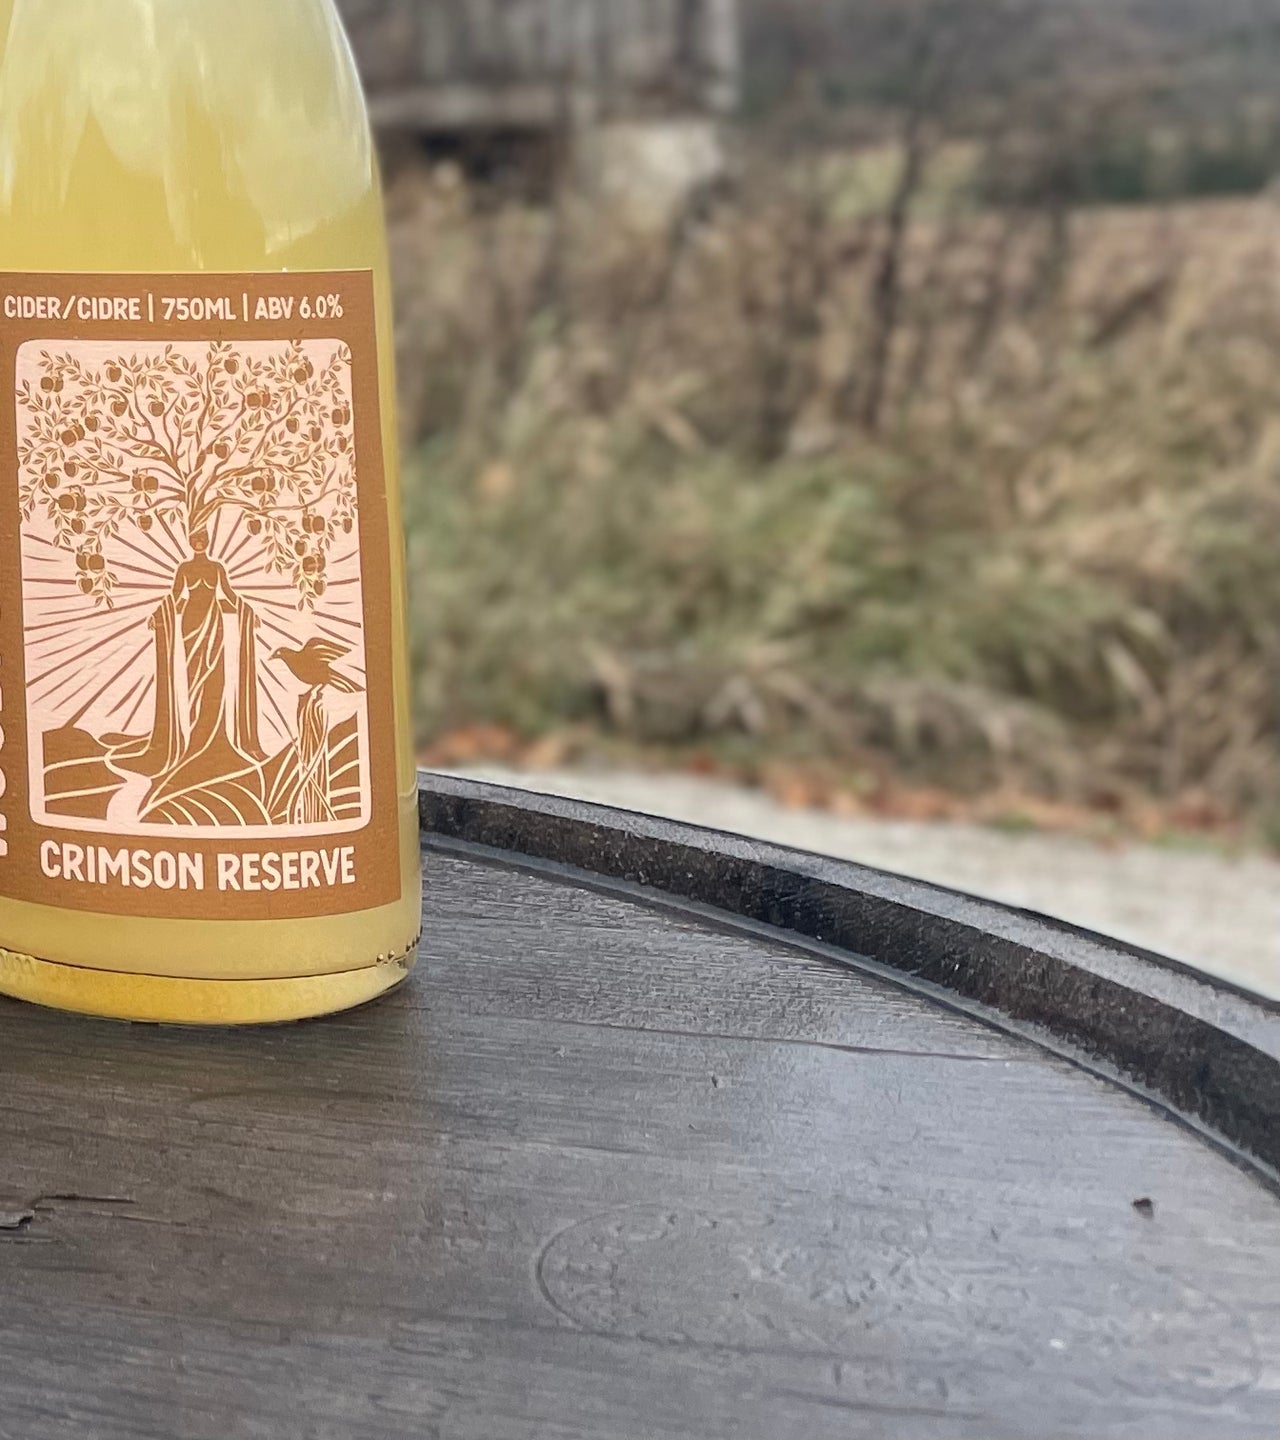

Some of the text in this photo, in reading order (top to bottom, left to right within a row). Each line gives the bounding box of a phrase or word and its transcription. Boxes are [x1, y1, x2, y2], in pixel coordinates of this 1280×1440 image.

[4, 293, 344, 321] CIDER/CIDRE 750ML ABV 6.0%
[39, 839, 356, 892] CRIMSON RESERVE
